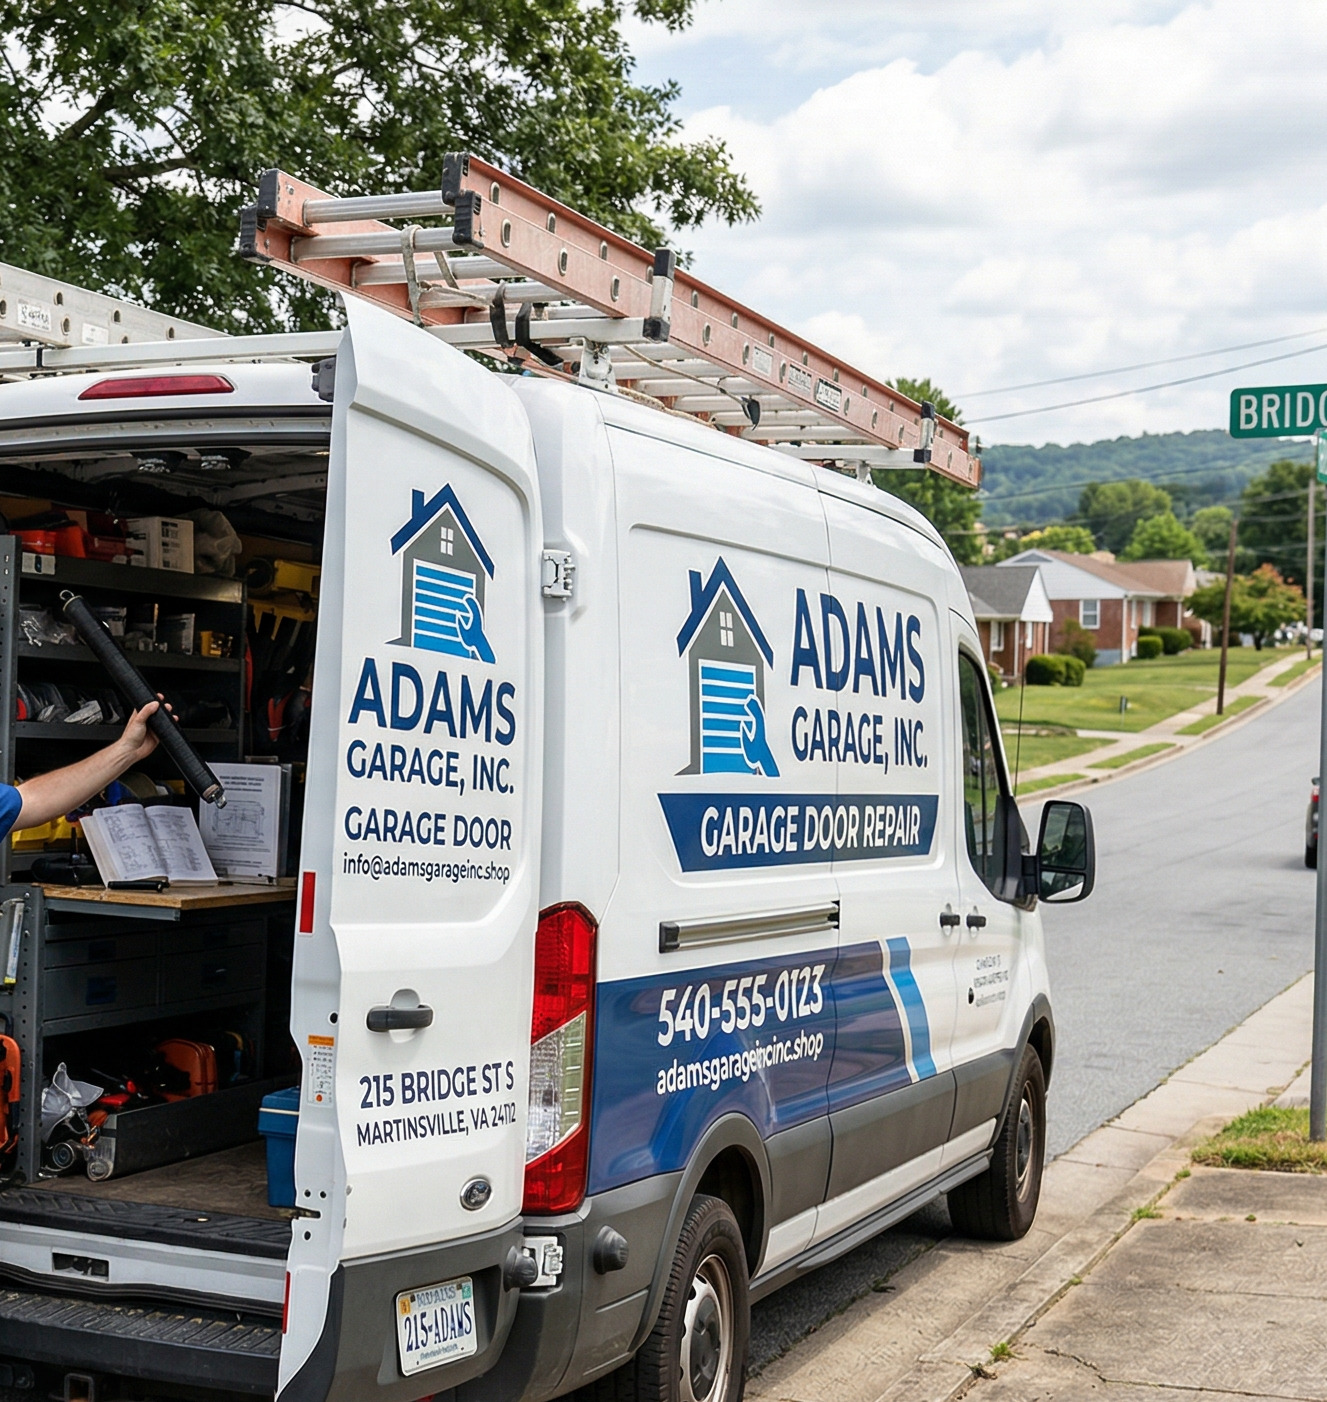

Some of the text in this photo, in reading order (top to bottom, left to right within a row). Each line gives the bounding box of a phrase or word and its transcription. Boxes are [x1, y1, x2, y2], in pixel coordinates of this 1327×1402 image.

[790, 587, 925, 704] ADAMS
[348, 657, 516, 746] ADAMS
[791, 705, 928, 775] GARAGE, INC.
[346, 739, 514, 796] GARAGE, INC.
[344, 806, 512, 850] GARAGE DOOR
[700, 805, 921, 857] GARAGE DOOR REPAIR
[343, 851, 510, 885] info@adamsgarageinc.shop
[657, 964, 826, 1047] 540-555-0123
[359, 1060, 514, 1109] 215 BRIDGE ST S
[356, 1110, 469, 1147] MARTINSVILLE,
[470, 1107, 489, 1130] VA
